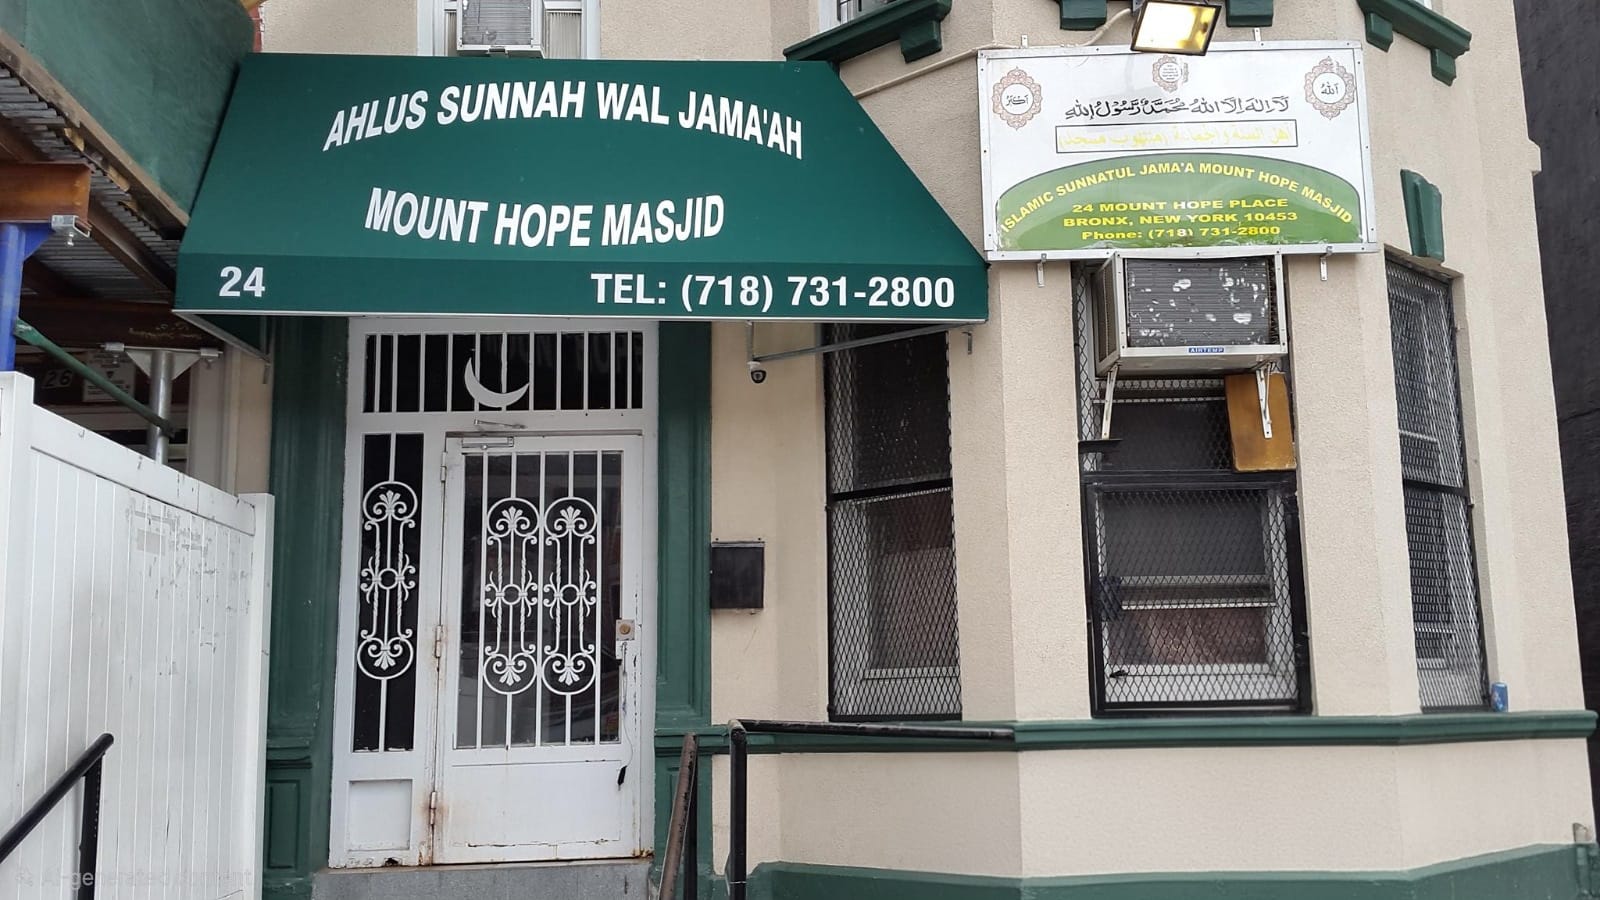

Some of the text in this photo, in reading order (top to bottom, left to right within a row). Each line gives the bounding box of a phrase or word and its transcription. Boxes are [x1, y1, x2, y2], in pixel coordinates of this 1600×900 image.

[322, 80, 803, 160] AHLUS SUNNAH WAL JAMA'AH
[1000, 162, 1353, 232] ISLAMIC SUNNATUL JAMA'A MOUNT HOPE MASJID
[1072, 198, 1289, 213] 24 MOUNT HOPE PLACE
[364, 187, 725, 248] MOUNT HOPE MASJID
[1063, 212, 1298, 227] BRONX, NEW YORK 10453
[1081, 226, 1281, 240] Phone: (718) 731-2800
[219, 266, 266, 298] 24
[590, 273, 955, 313] TEL: (718) 731-2800
